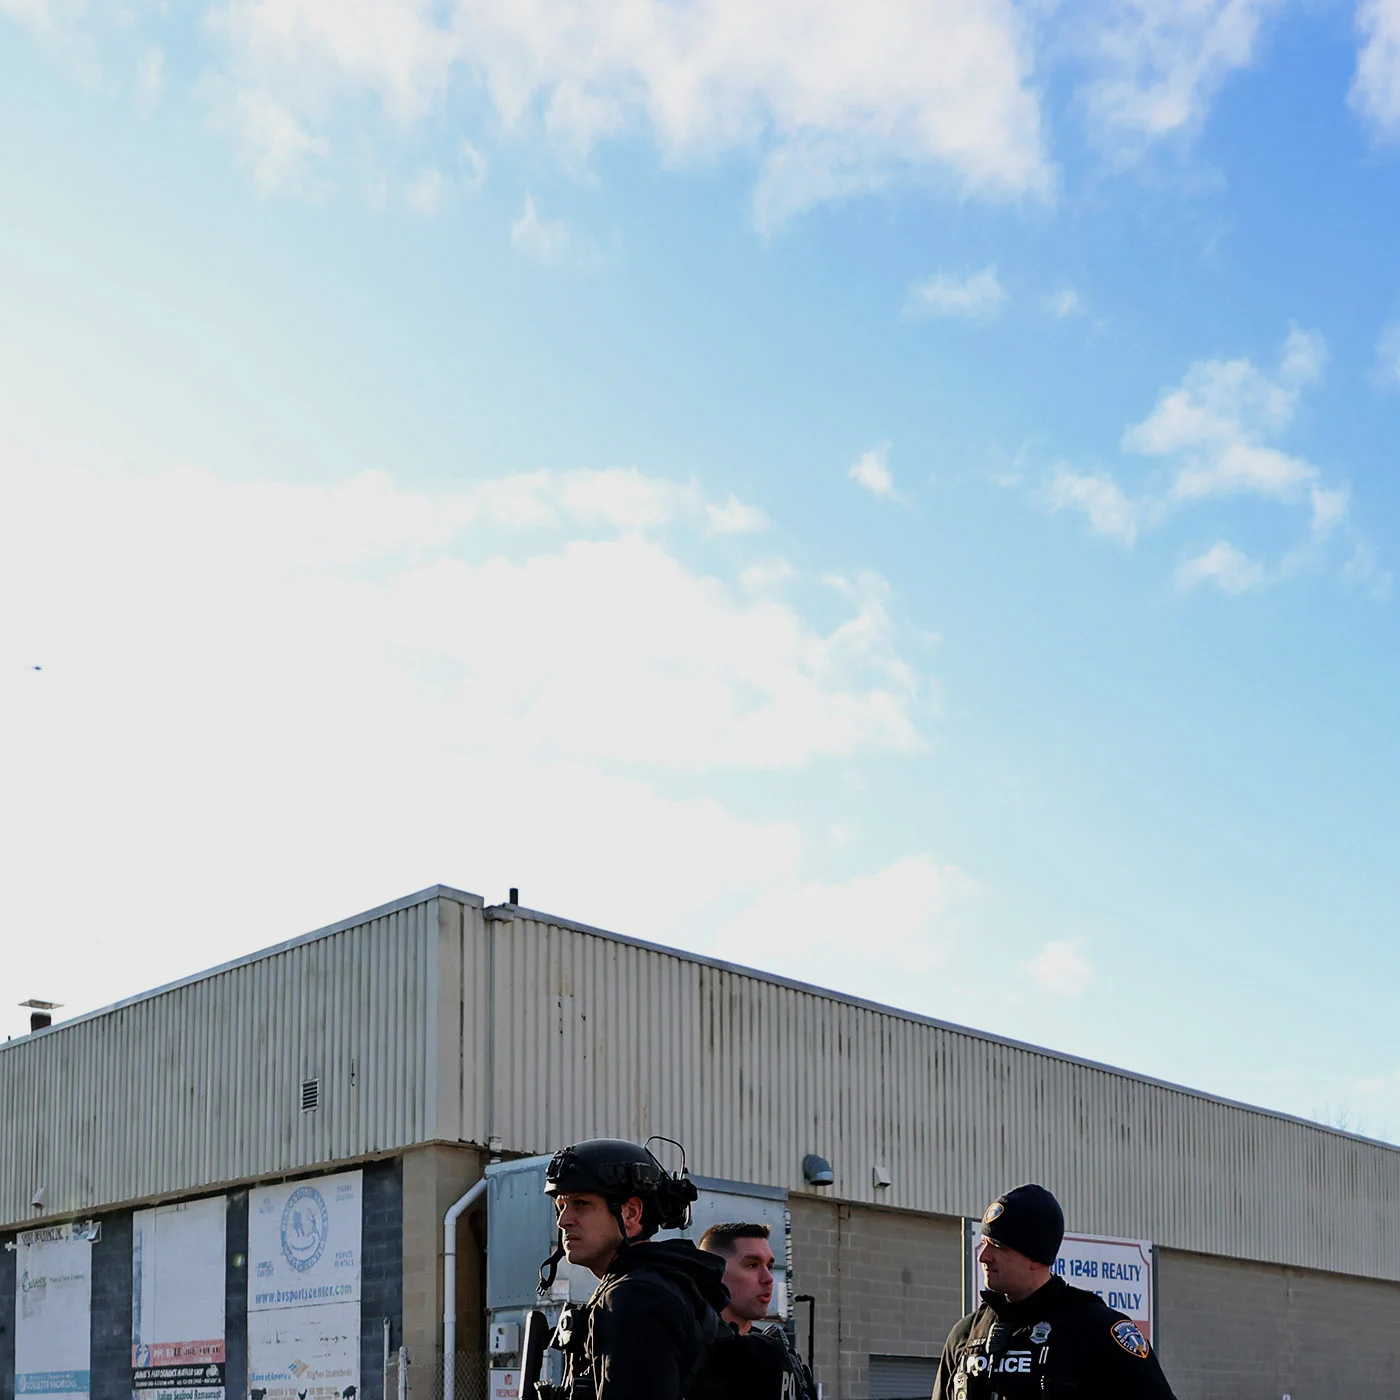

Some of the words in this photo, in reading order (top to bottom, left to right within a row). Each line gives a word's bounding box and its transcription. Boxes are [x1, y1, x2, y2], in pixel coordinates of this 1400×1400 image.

[1102, 1261, 1142, 1282] REALTY
[255, 1284, 352, 1304] www.bvsportscenter.com
[1108, 1291, 1142, 1310] ONLY
[174, 1389, 194, 1400] Seafood
[194, 1389, 221, 1399] Restaurant
